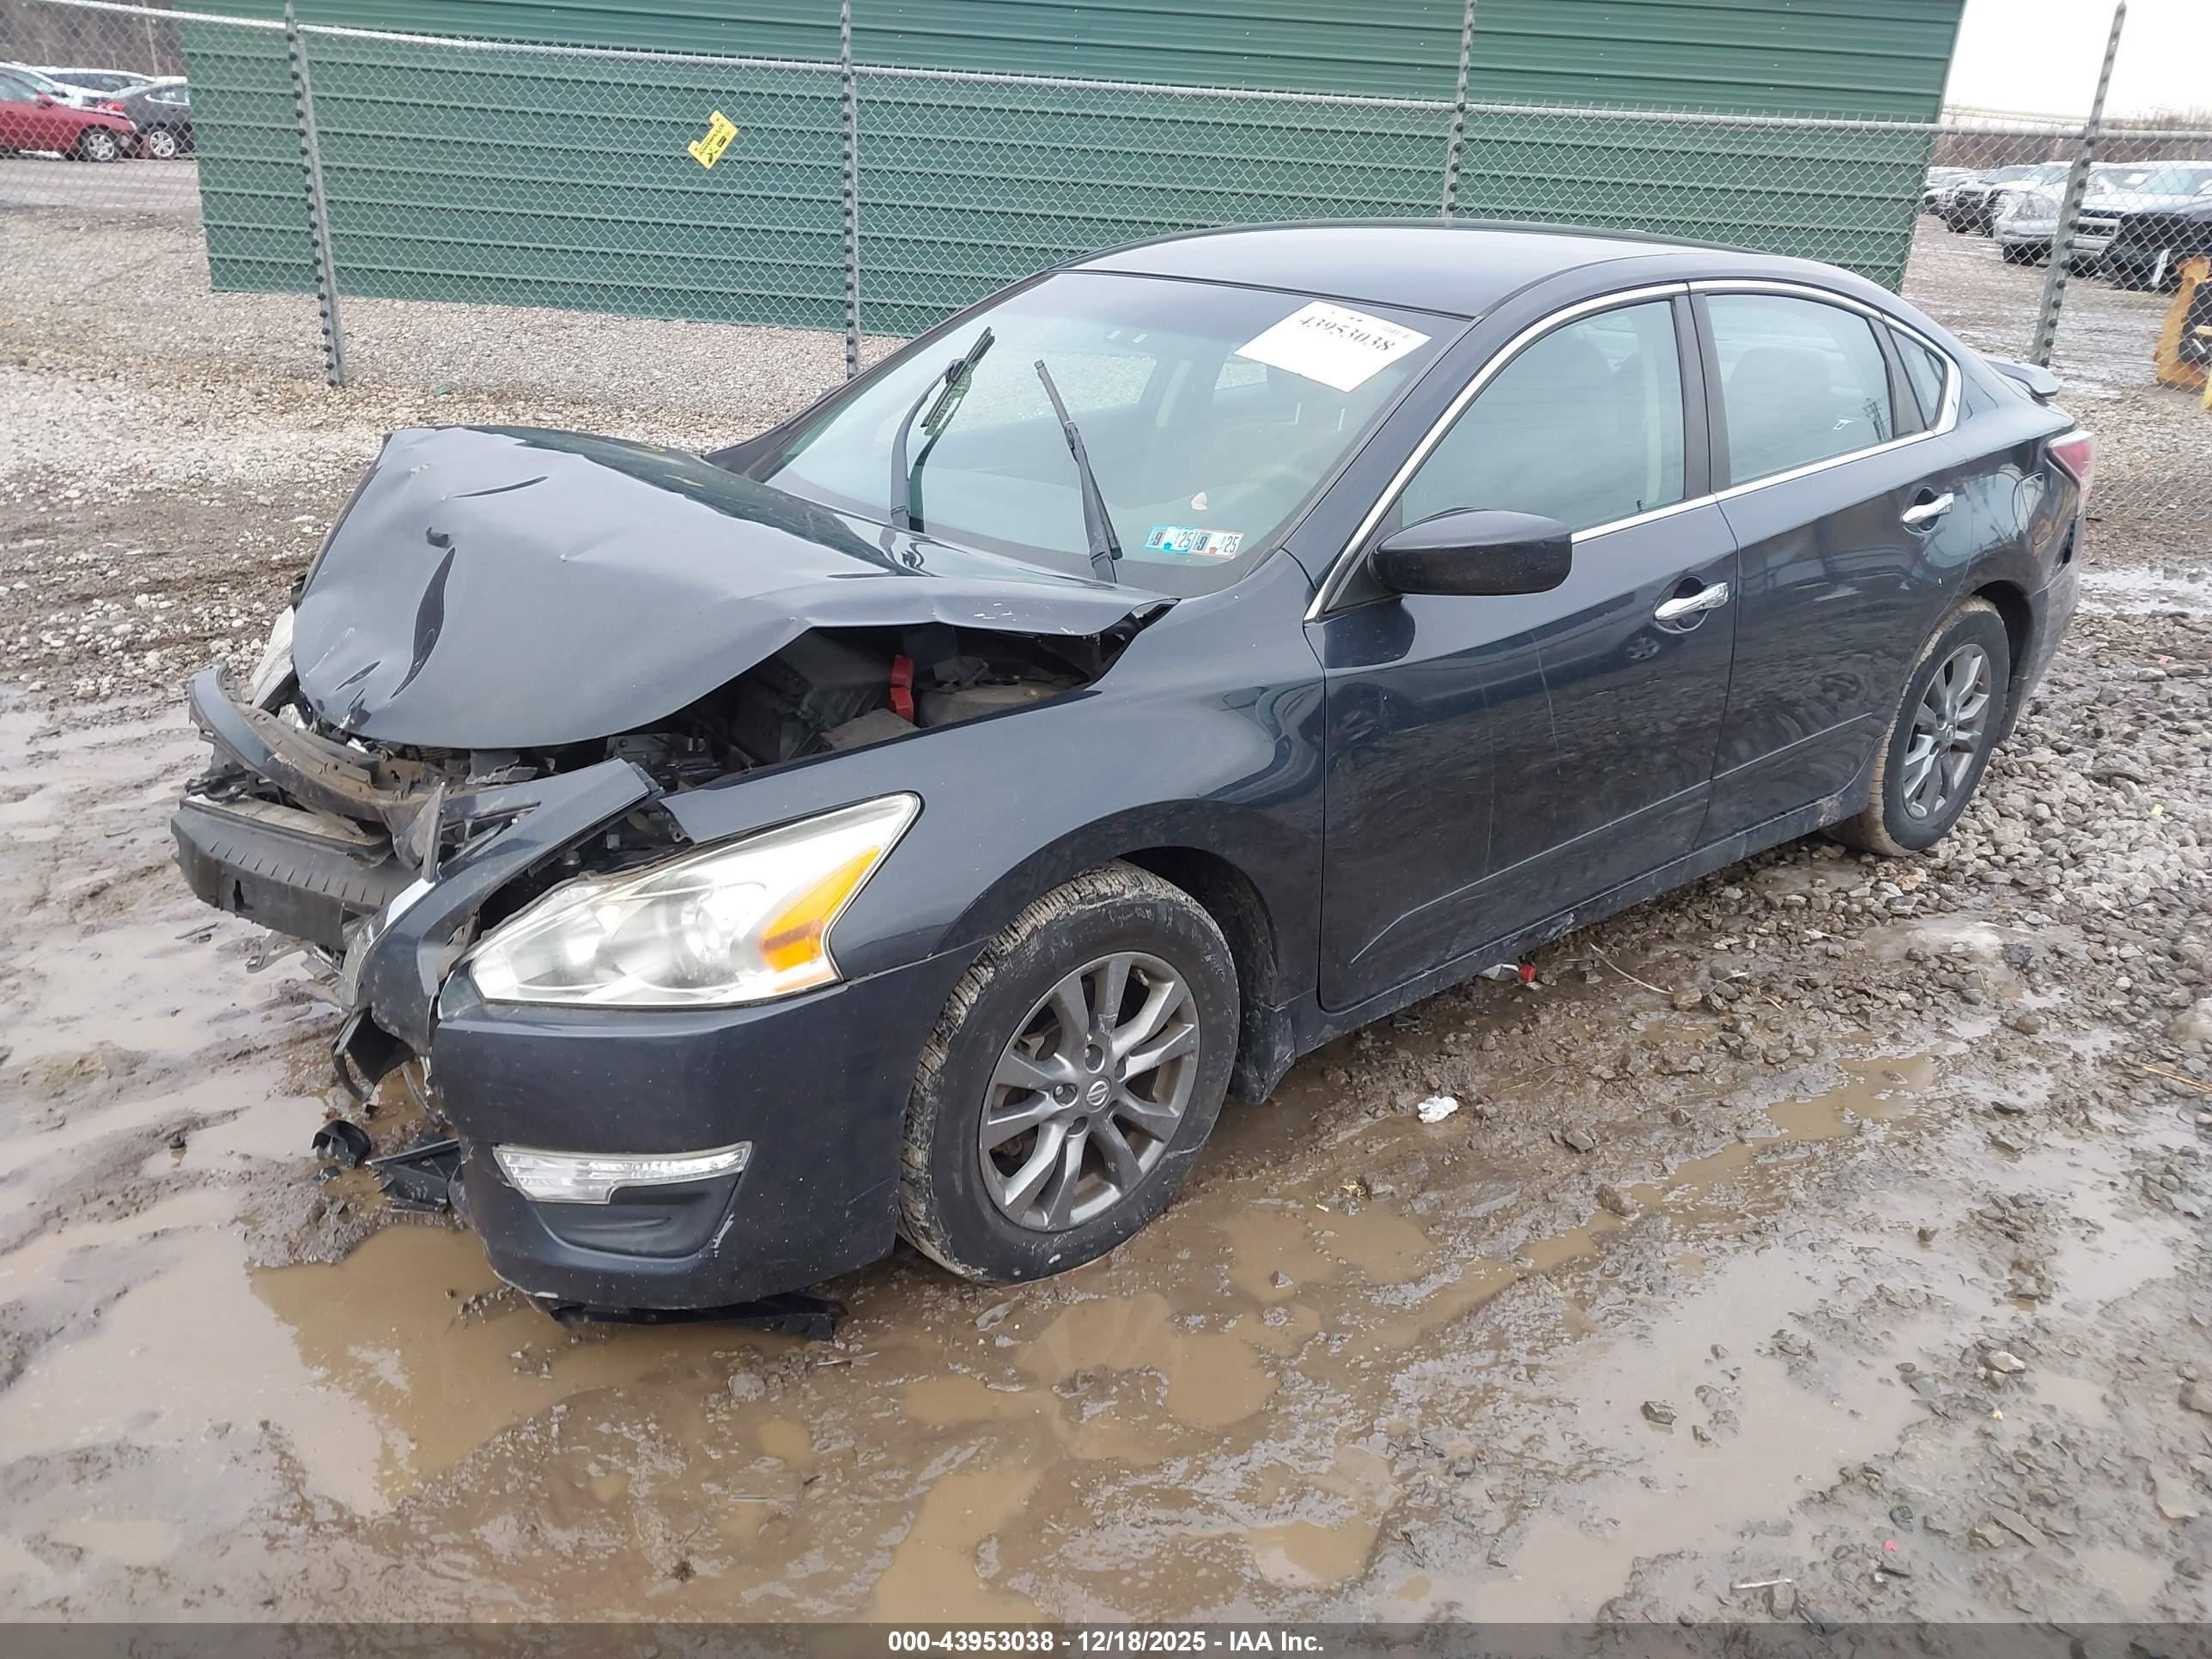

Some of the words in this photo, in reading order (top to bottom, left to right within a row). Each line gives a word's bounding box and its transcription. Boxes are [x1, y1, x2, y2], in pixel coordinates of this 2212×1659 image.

[1298, 315, 1396, 351] 43953038
[1178, 531, 1194, 548] 25
[1223, 535, 1240, 553] 25
